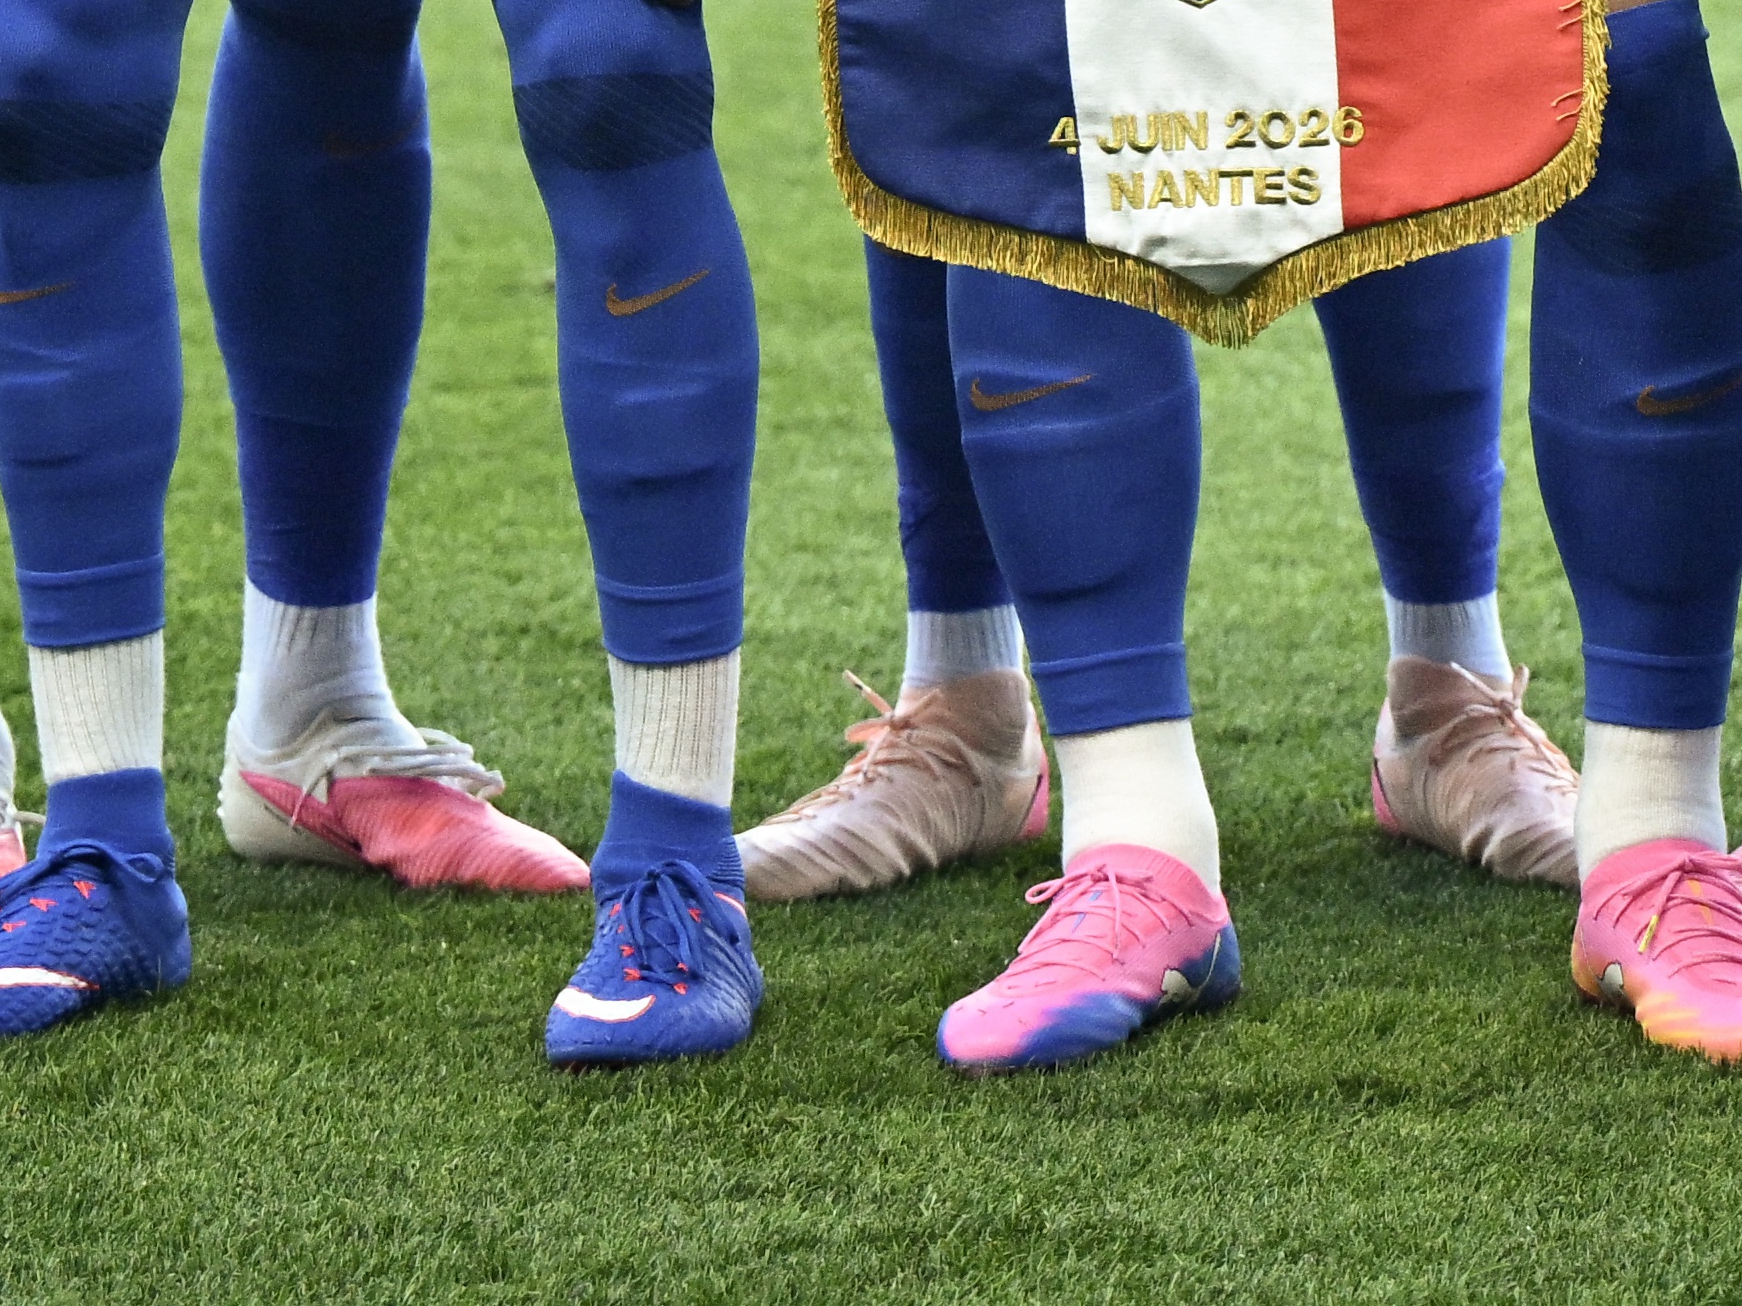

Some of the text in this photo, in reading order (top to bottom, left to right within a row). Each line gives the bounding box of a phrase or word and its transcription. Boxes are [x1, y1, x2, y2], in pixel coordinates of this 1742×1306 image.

[1049, 106, 1365, 155] 4 JUIN 2026
[1108, 165, 1322, 212] NANTES
